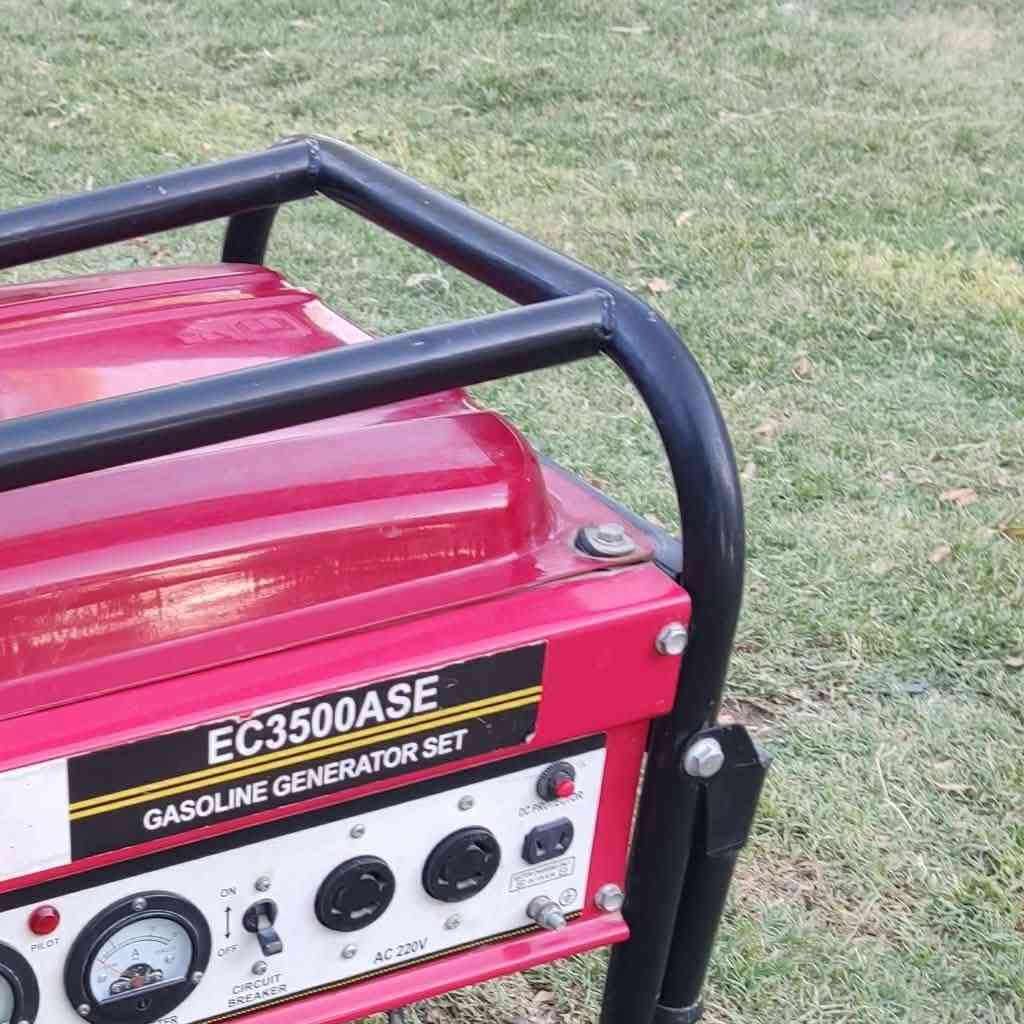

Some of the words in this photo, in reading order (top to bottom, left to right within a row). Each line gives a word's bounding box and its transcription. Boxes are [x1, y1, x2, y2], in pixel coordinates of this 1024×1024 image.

[207, 675, 440, 764] EC3500ASE
[143, 781, 268, 831] GASOLINE
[273, 741, 418, 797] GENERATOR
[423, 729, 468, 759] SET
[220, 887, 237, 898] ON
[31, 938, 60, 952] PILOT
[217, 944, 239, 957] OFF
[374, 948, 393, 964] AC
[396, 937, 428, 957] 220V
[232, 973, 281, 994] CIRCUIT
[228, 984, 287, 1008] BREAKER
